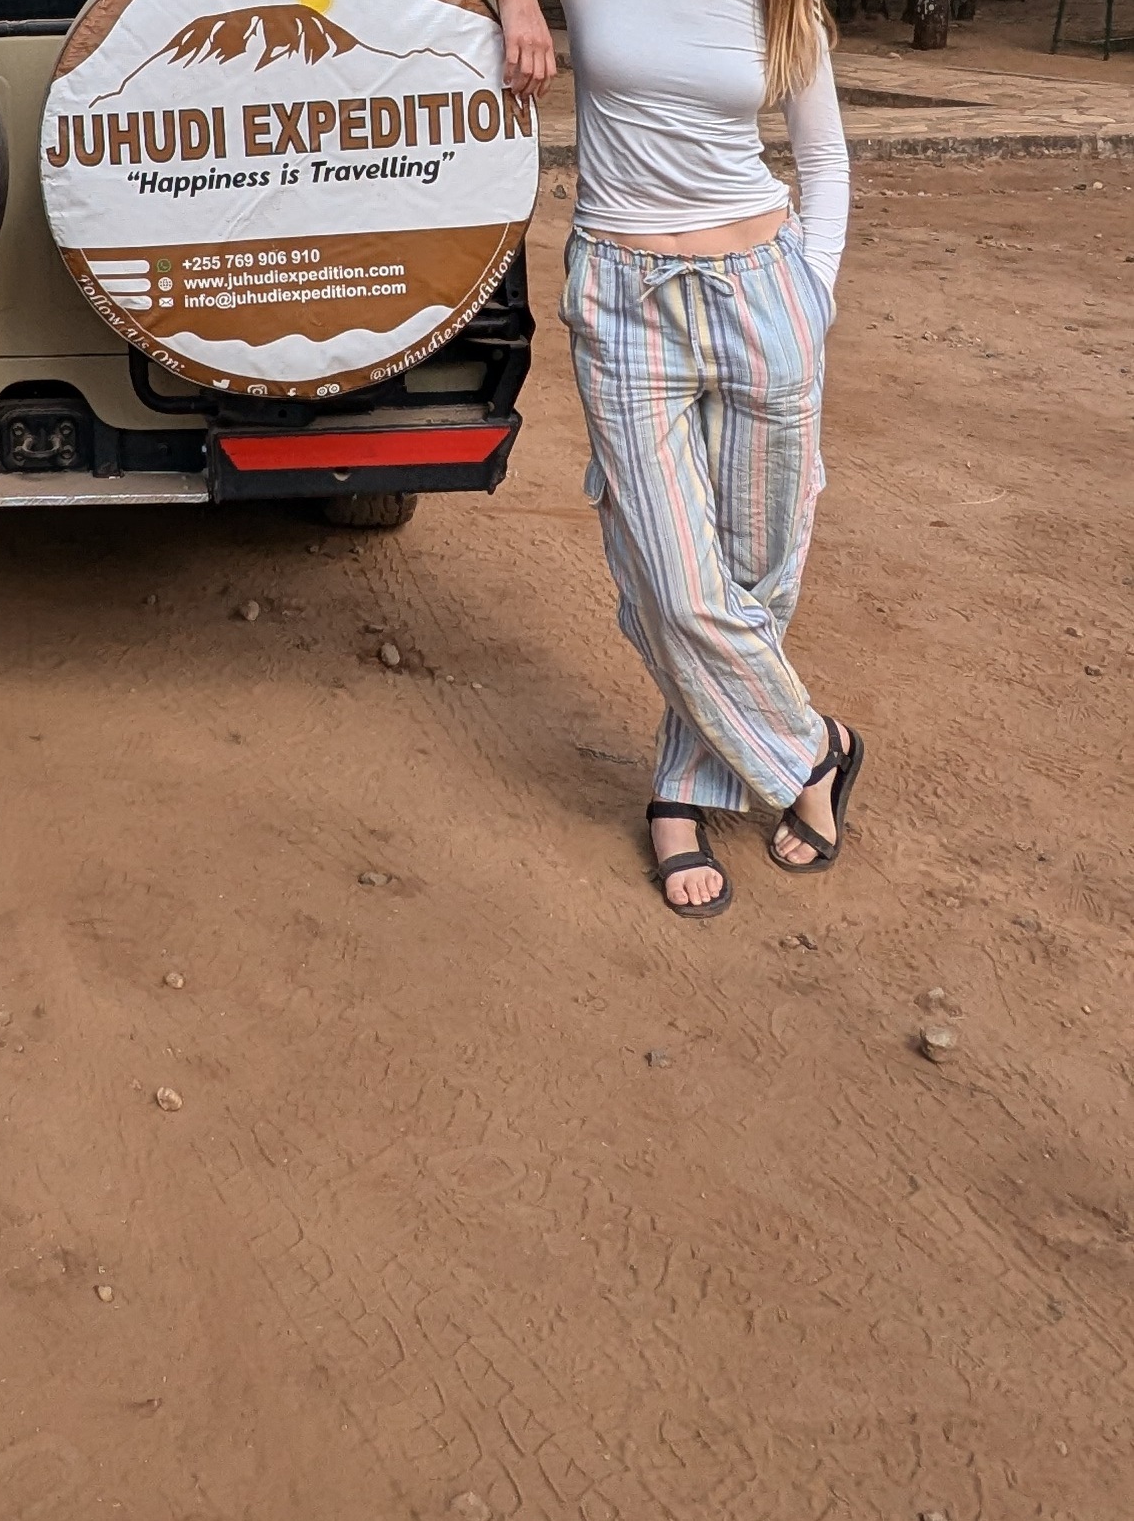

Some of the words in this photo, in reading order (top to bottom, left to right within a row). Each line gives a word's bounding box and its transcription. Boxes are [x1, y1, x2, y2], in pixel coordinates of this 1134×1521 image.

[46, 107, 227, 168] JUHUDI
[242, 87, 533, 156] EXPEDITION
[127, 169, 270, 198] “Happiness
[280, 163, 300, 183] is
[310, 152, 454, 185] Travelling”
[182, 255, 221, 270] +255
[224, 253, 253, 268] 769
[257, 252, 287, 266] 906
[291, 250, 320, 265] 910
[184, 263, 404, 290] www.juhudiexpedition.com
[184, 281, 406, 309] info@juhudiexpedition.com
